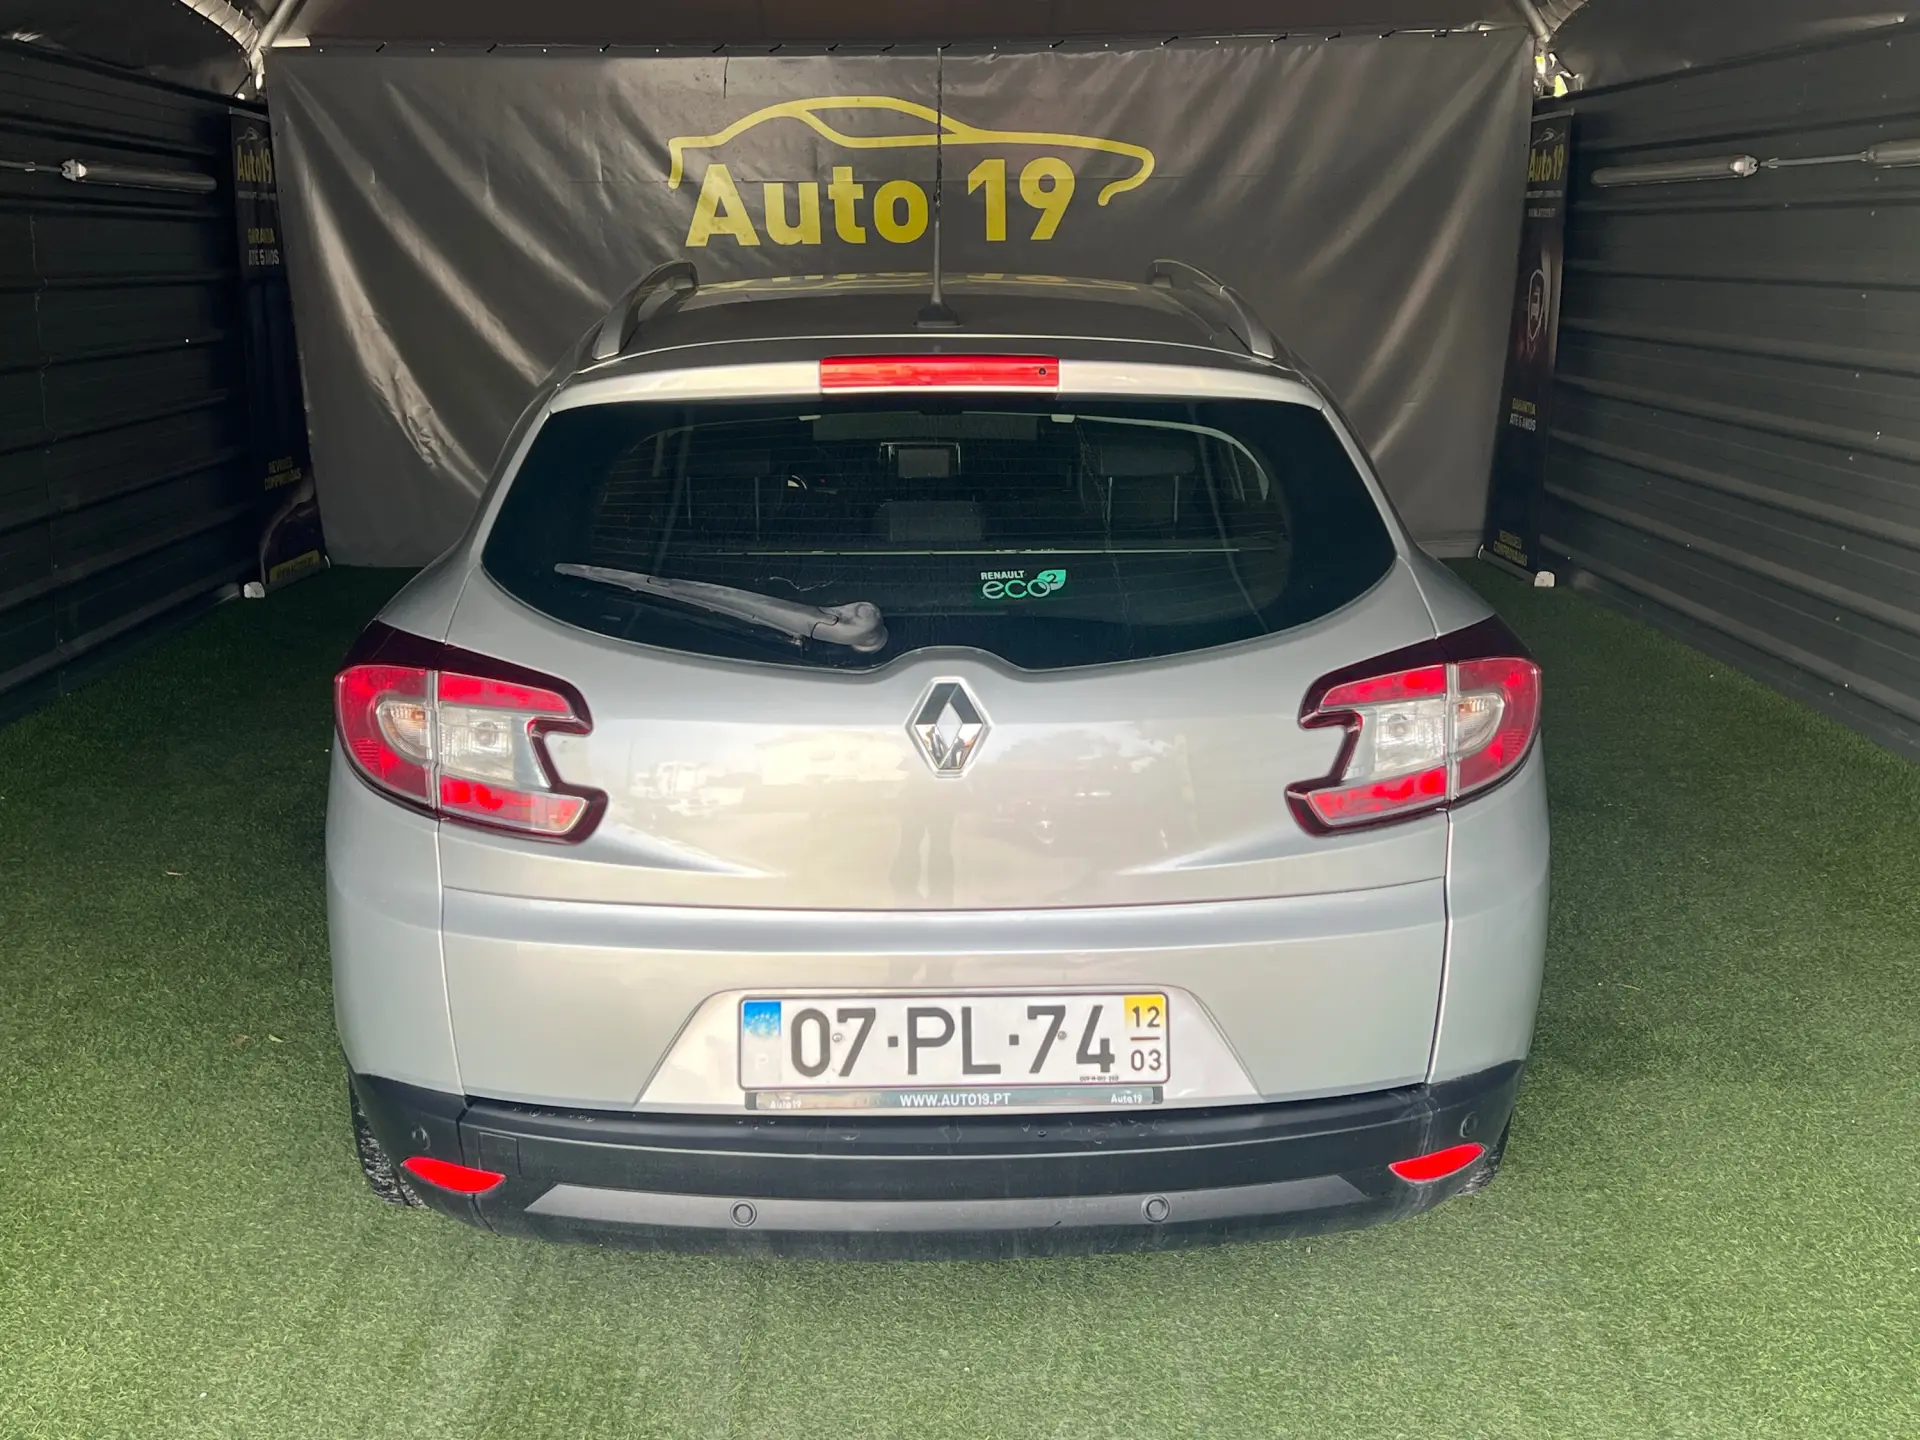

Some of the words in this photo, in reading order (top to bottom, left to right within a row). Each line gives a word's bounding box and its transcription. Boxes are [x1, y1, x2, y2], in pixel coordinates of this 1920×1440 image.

[1528, 148, 1552, 182] Auto
[1553, 144, 1564, 180] 19
[685, 163, 929, 247] Auto
[967, 156, 1076, 242] 19
[980, 570, 1025, 580] RENAULT
[1131, 1005, 1161, 1029] 12
[1130, 1049, 1162, 1072] 03
[899, 1092, 1011, 1107] WWW.AUTO19.PT
